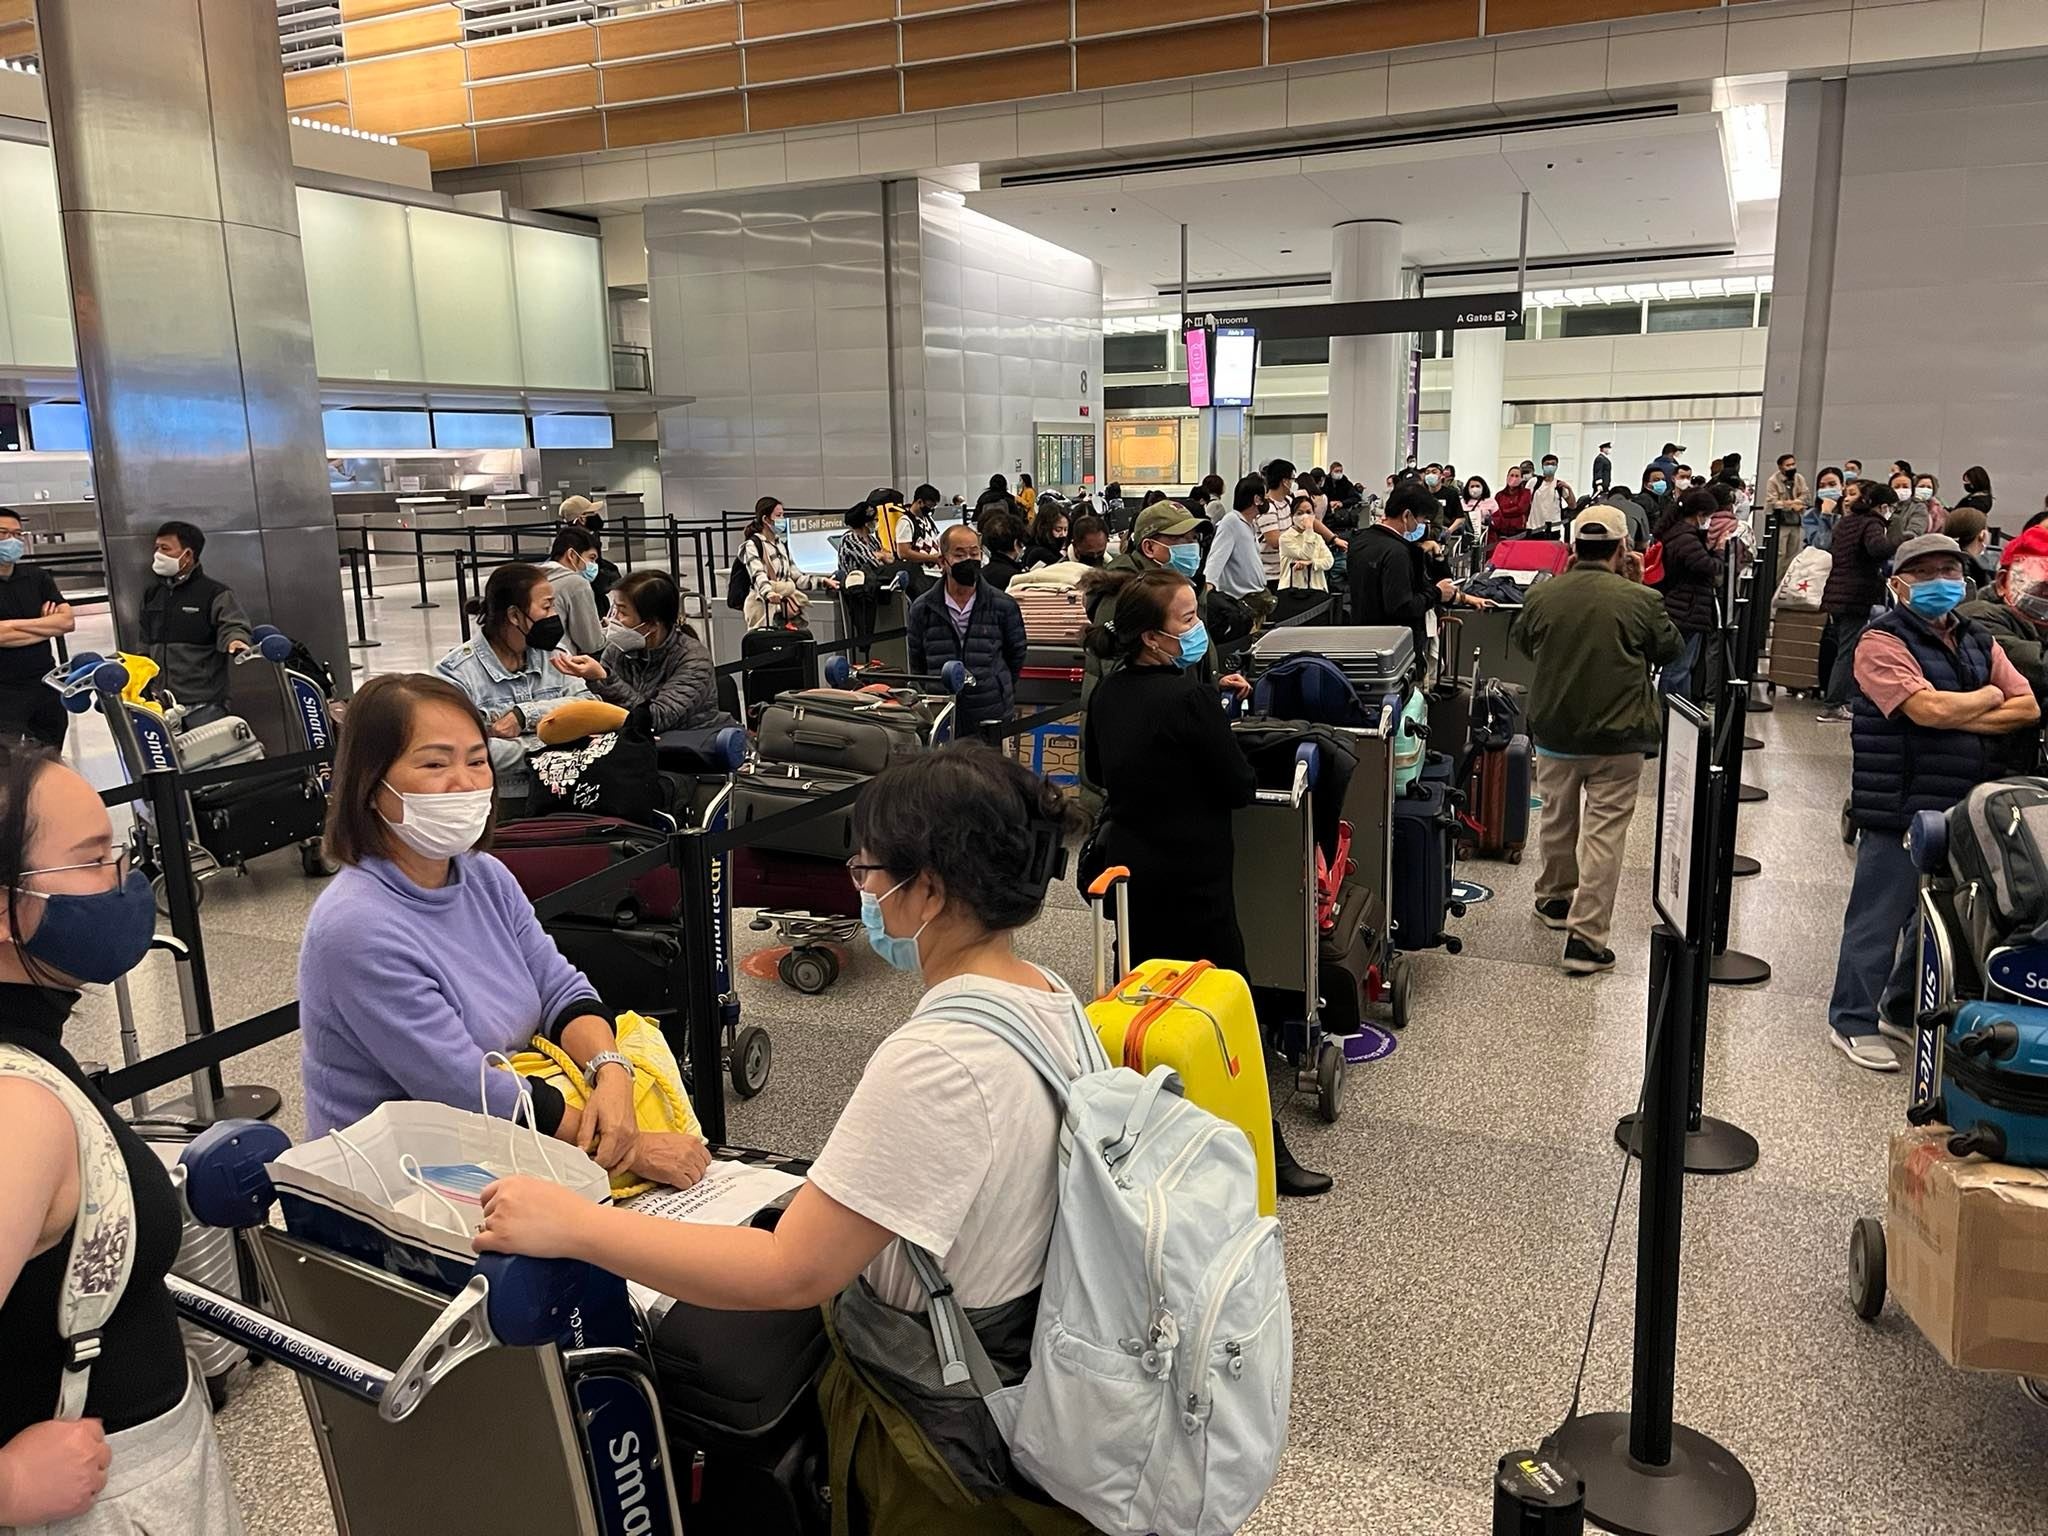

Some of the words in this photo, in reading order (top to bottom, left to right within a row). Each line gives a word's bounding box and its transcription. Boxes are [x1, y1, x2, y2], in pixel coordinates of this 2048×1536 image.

[1205, 315, 1249, 326] strooms
[1457, 314, 1464, 323] A
[1466, 313, 1493, 323] Gates
[1080, 370, 1088, 394] 8
[821, 518, 843, 529] Service
[196, 1299, 212, 1311] or
[227, 1312, 269, 1339] Handle
[268, 1331, 282, 1345] to
[282, 1334, 328, 1366] Release
[327, 1355, 364, 1382] Brake
